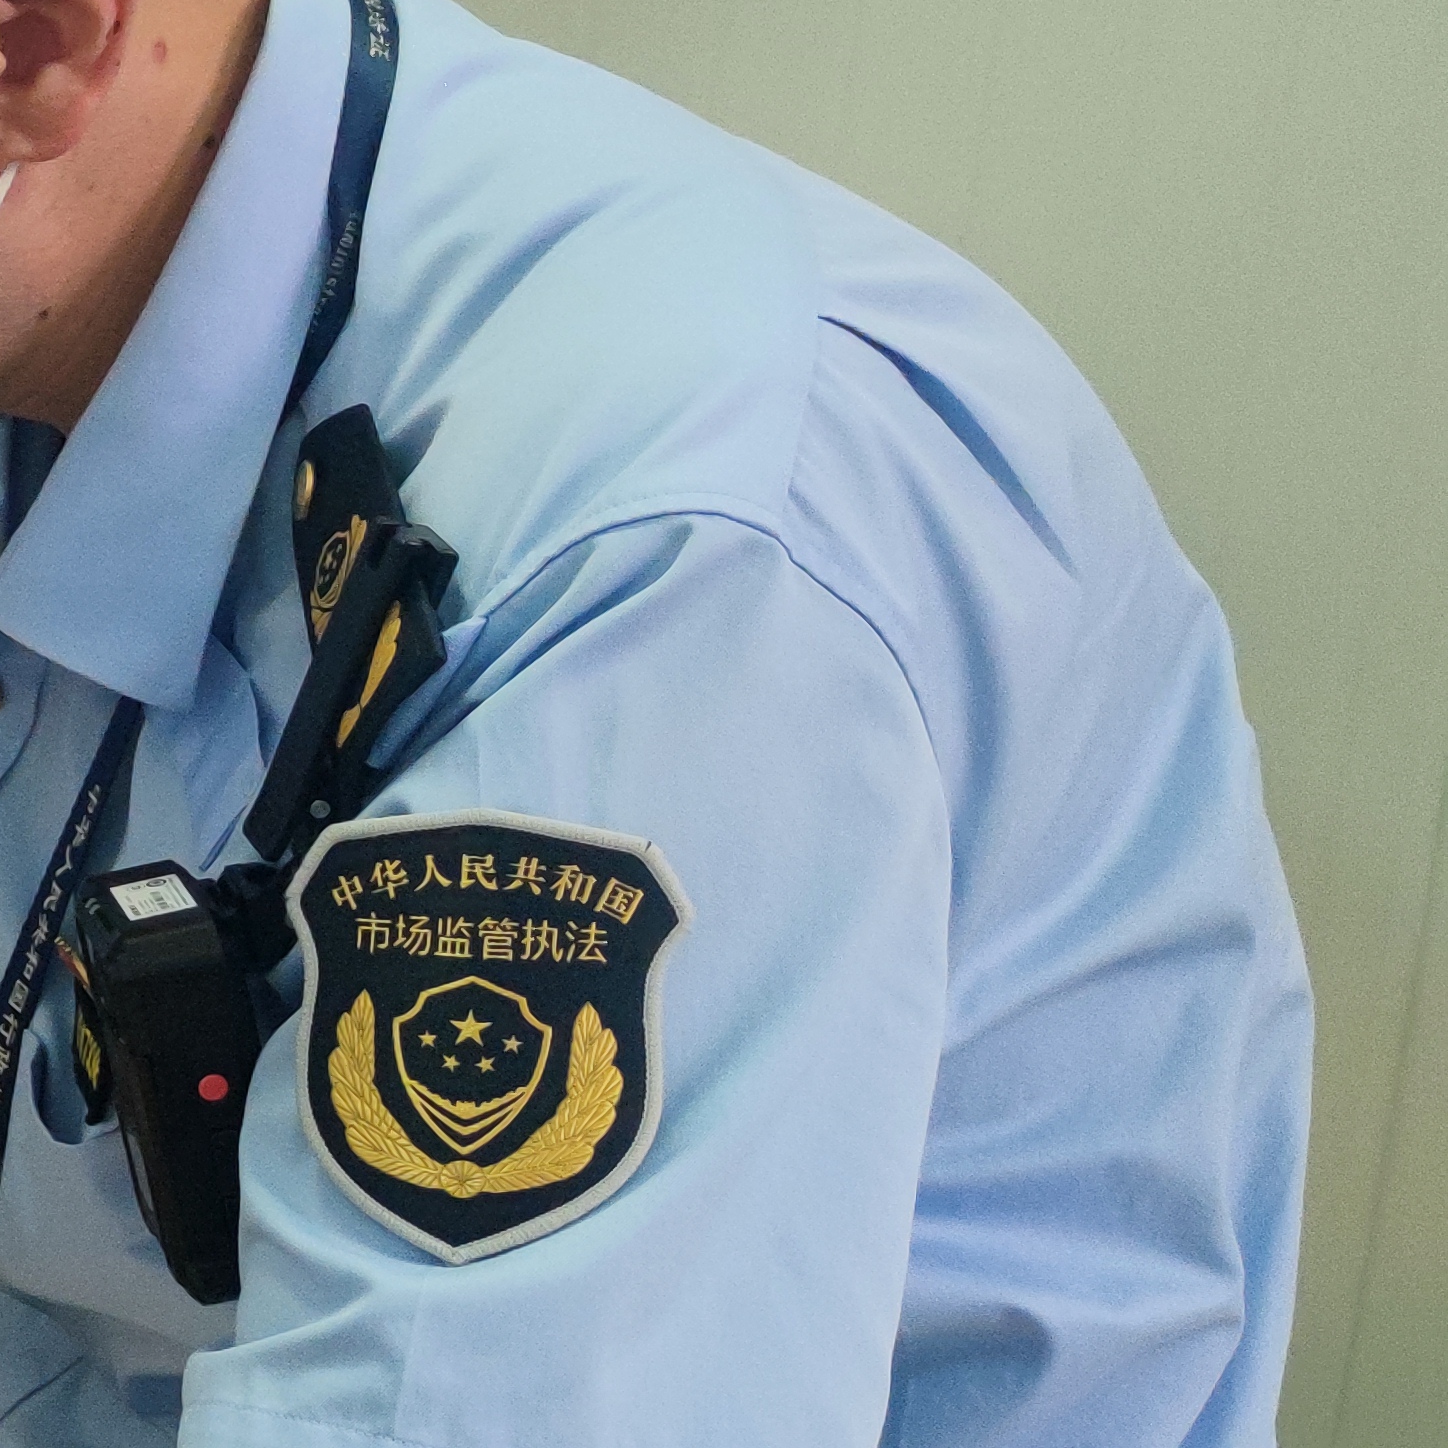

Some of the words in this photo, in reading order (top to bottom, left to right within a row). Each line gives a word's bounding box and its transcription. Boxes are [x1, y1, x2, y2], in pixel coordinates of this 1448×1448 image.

[330, 852, 645, 927] 中华人民共和国
[355, 913, 609, 964] 市场监管执法
